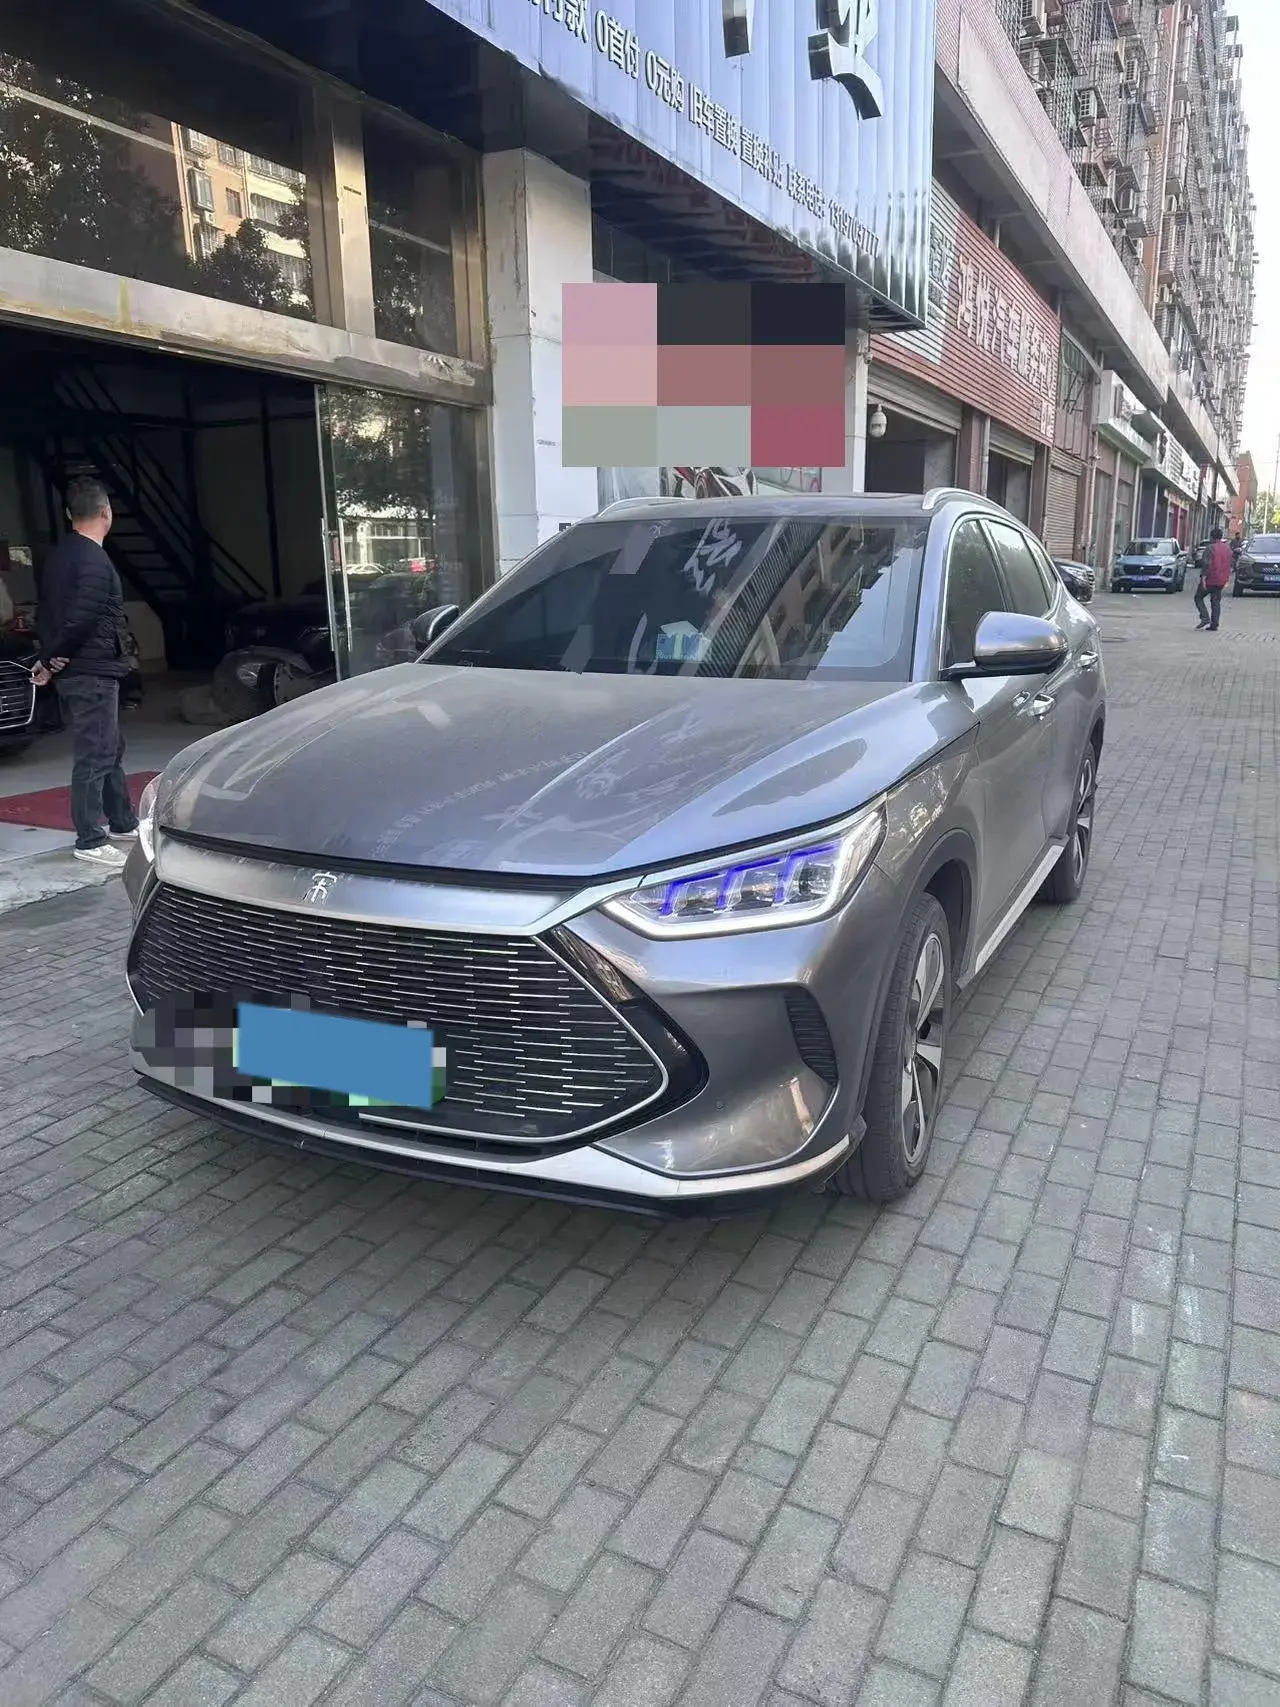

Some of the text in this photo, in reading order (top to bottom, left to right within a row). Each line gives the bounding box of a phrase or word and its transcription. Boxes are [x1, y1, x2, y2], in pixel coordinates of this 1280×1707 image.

[595, 9, 640, 79] 0首付
[645, 50, 685, 112] 0元购
[688, 83, 740, 155] 旧车置换
